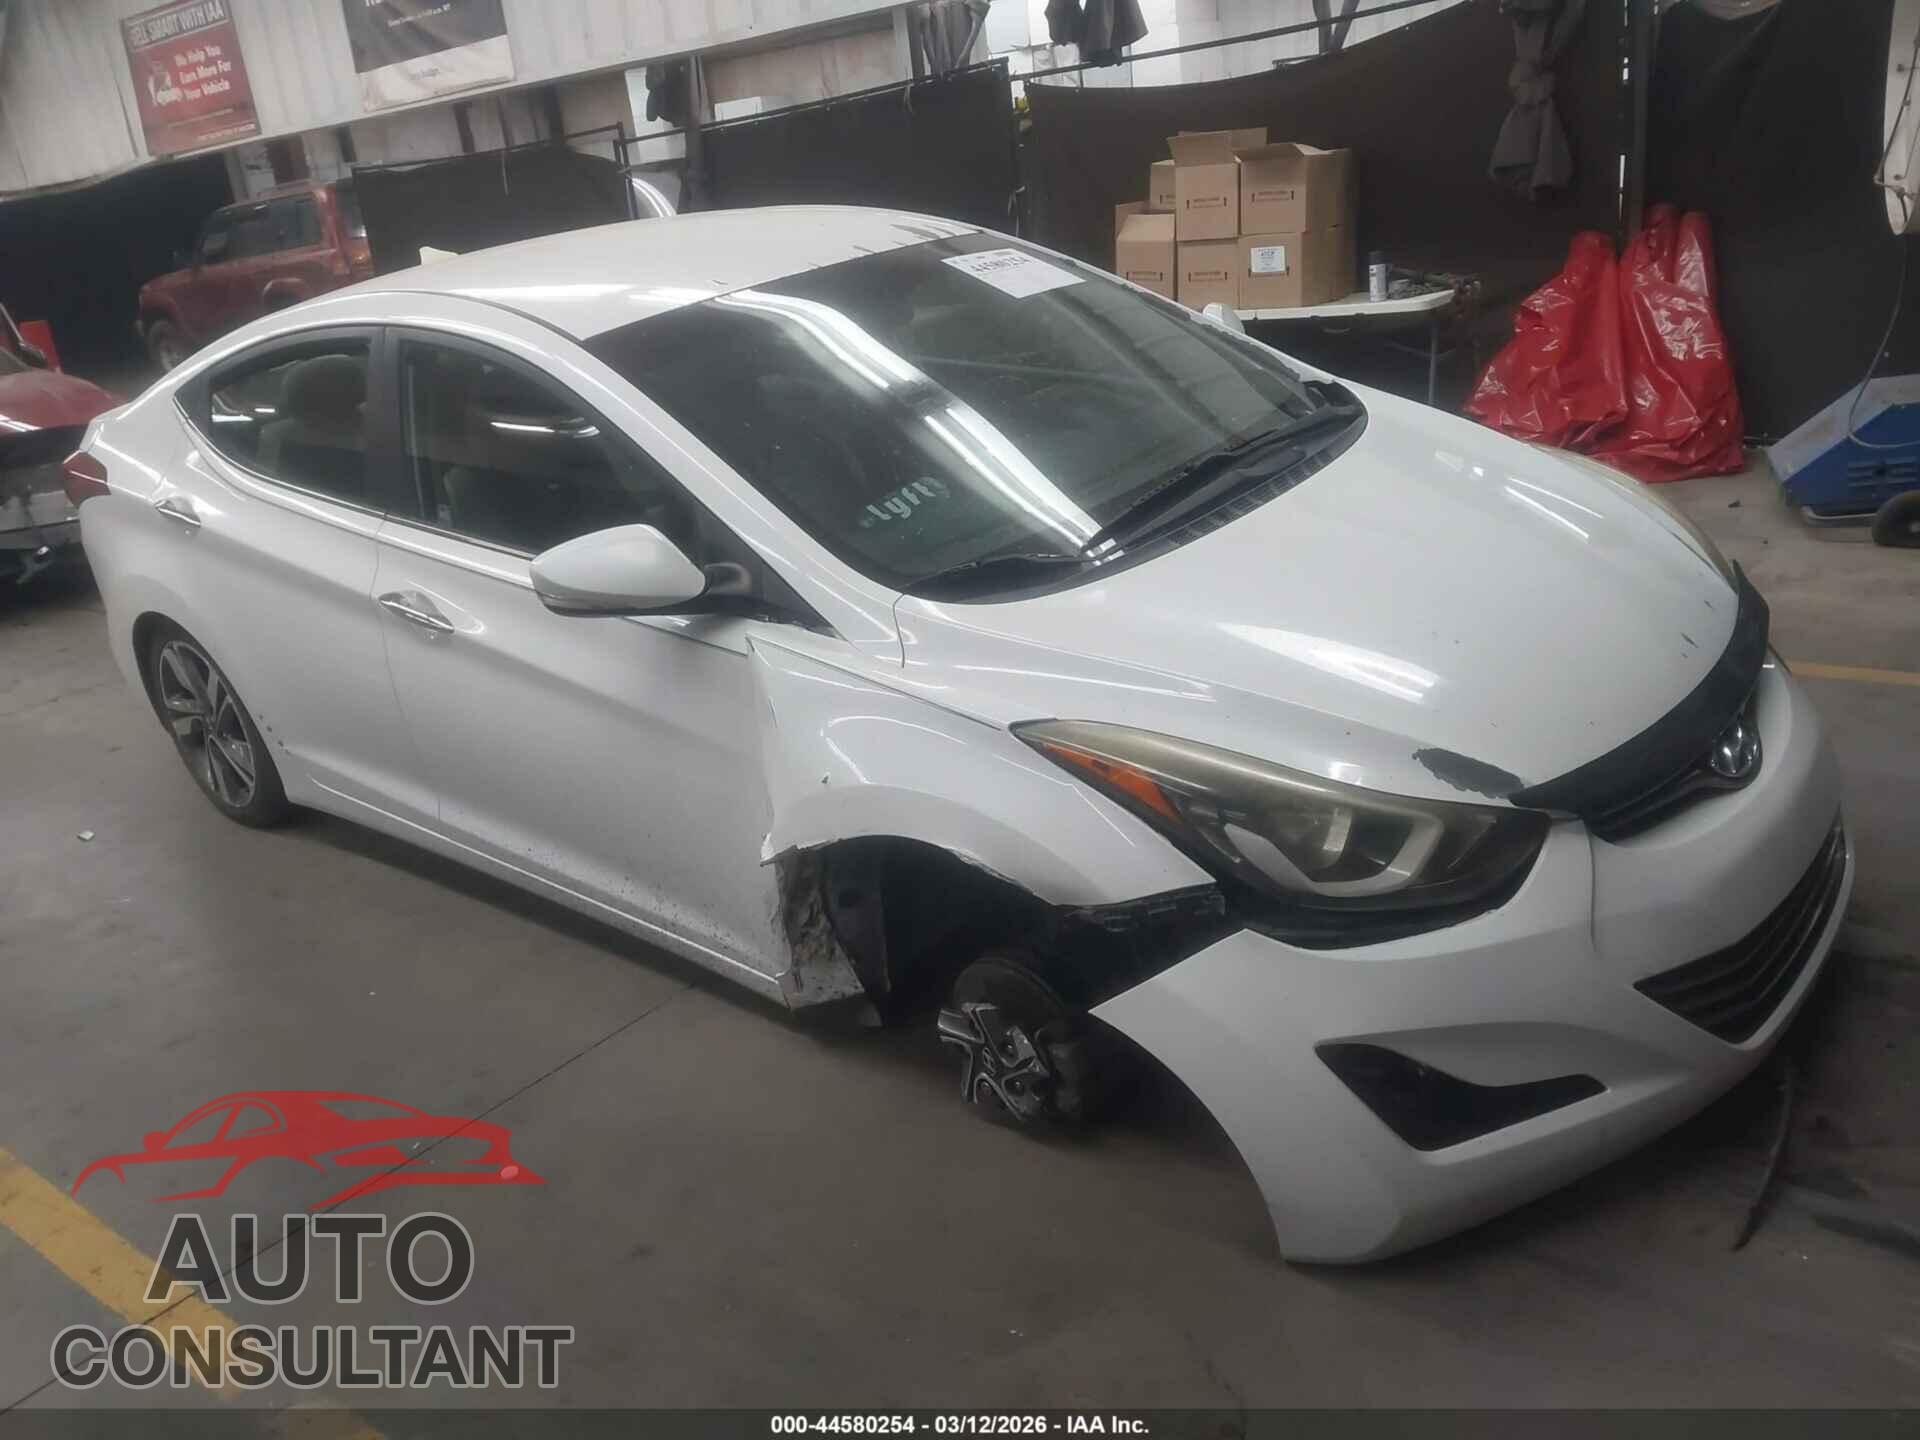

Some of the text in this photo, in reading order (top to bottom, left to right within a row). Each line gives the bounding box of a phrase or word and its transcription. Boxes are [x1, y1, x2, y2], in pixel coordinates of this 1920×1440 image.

[147, 14, 180, 39] SMART
[179, 5, 206, 31] WITH
[204, 0, 226, 21] IAA
[204, 45, 221, 57] You
[196, 65, 218, 79] More
[217, 60, 232, 72] For
[200, 78, 230, 96] Vehicle
